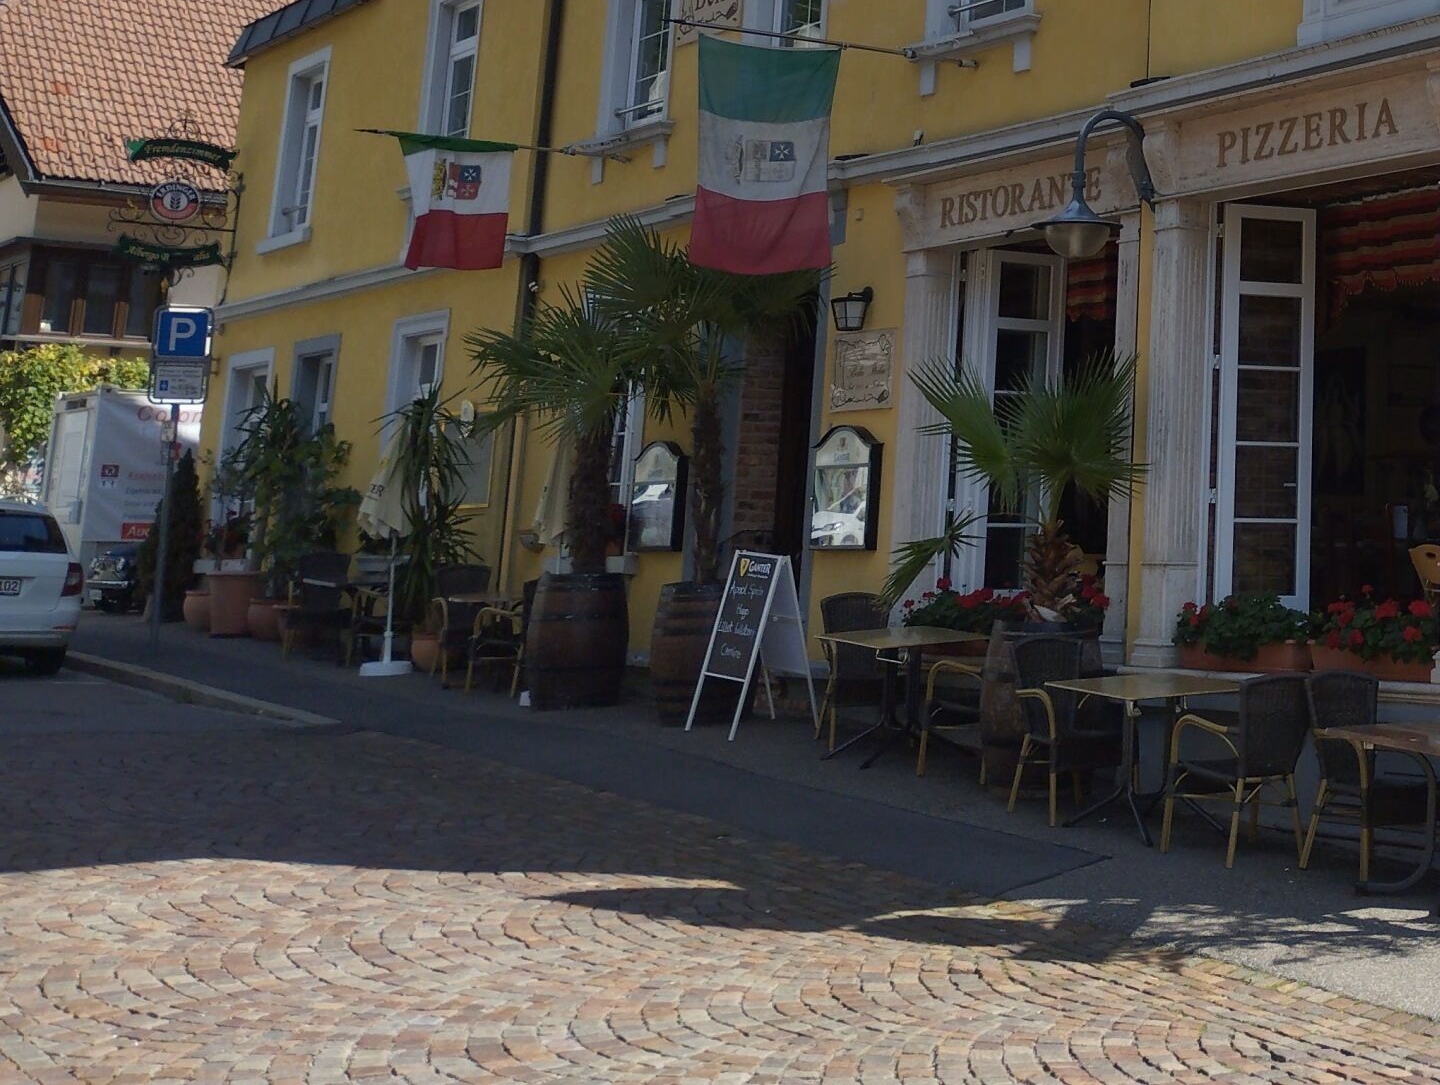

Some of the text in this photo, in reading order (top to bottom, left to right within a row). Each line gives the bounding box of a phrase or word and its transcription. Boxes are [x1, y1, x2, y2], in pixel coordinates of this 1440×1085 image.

[1215, 98, 1400, 168] PIZZERIA
[939, 166, 1102, 229] RISTORANE
[168, 317, 197, 352] P
[748, 560, 772, 575] GANTER
